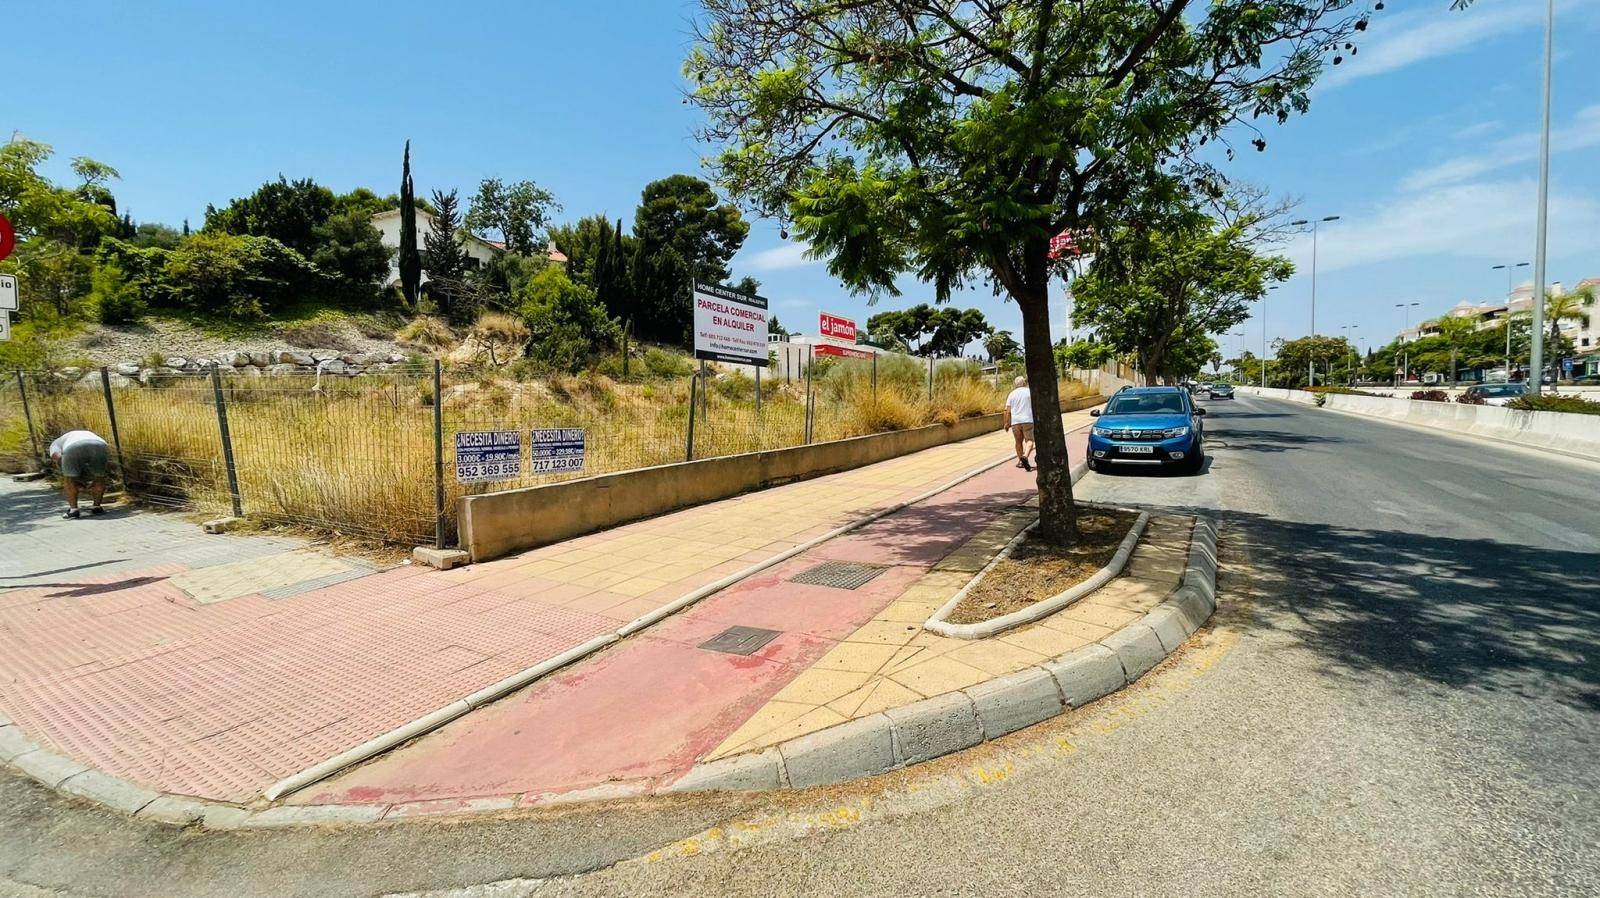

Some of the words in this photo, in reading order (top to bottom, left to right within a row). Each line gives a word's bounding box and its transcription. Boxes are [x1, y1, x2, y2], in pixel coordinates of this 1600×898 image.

[697, 283, 714, 294] HOME
[715, 288, 737, 299] CENTER
[737, 294, 748, 303] SUR
[697, 299, 729, 314] PARCELA
[730, 307, 766, 323] COMERCIAL
[713, 316, 722, 326] EN
[723, 318, 755, 332] ALQUILER
[822, 316, 829, 331] el
[457, 433, 493, 447] ¿NECESITA
[493, 432, 520, 445] DINERO?
[458, 466, 478, 477] 952
[481, 465, 500, 476] 369
[502, 463, 520, 473] 555
[533, 460, 550, 470] 717
[552, 459, 567, 469] 123
[568, 458, 584, 467] 007
